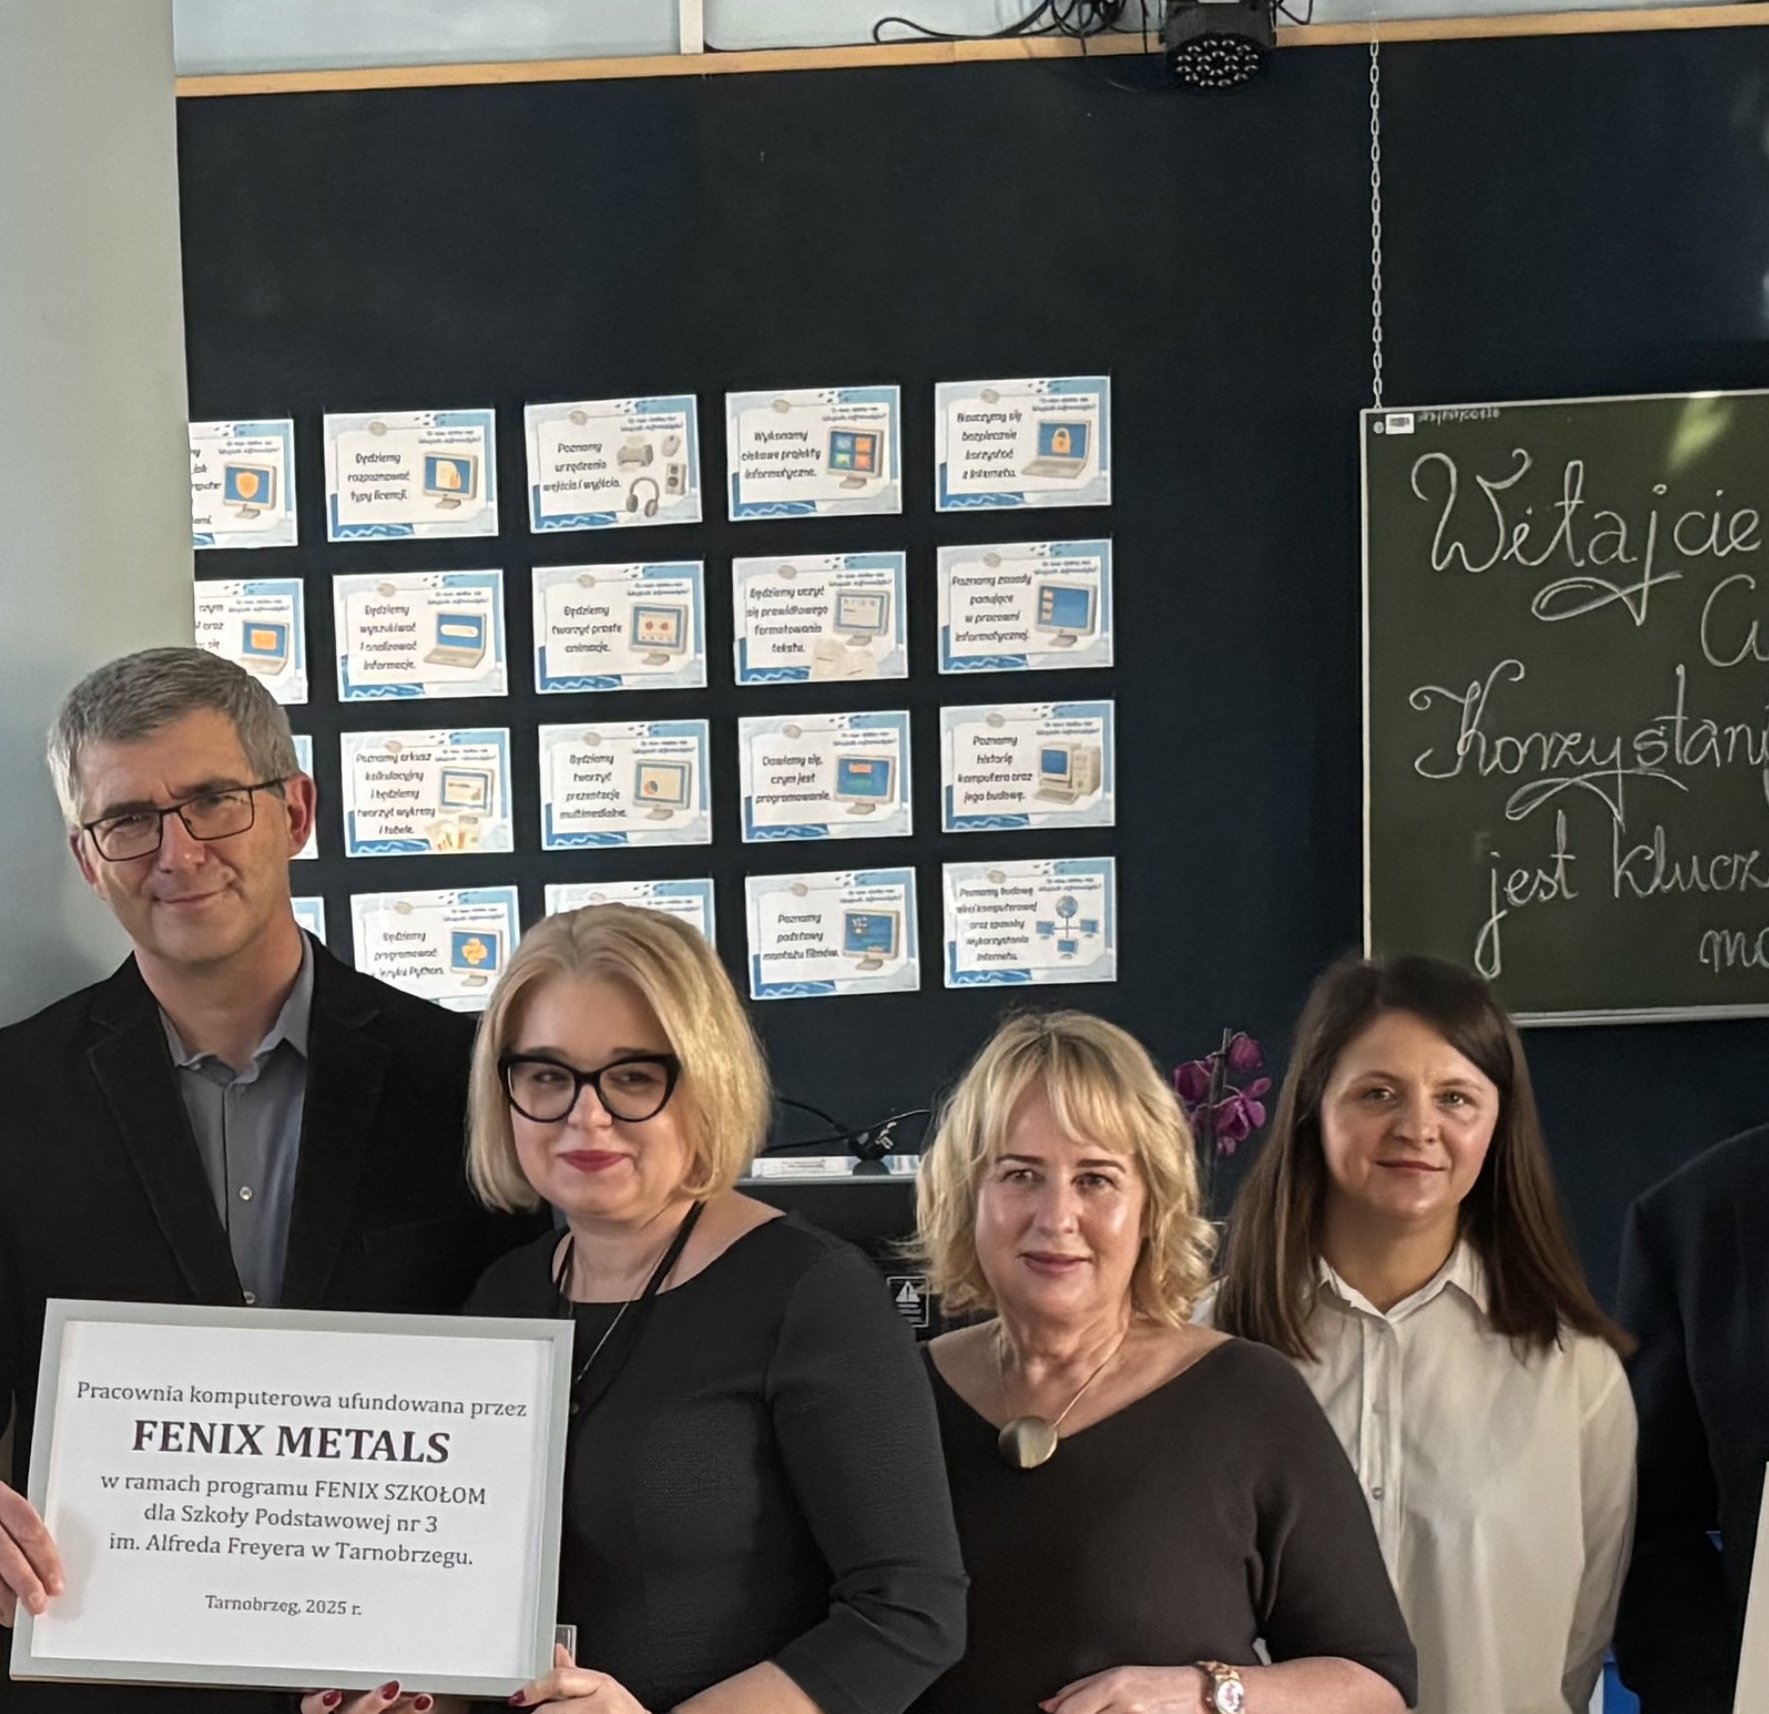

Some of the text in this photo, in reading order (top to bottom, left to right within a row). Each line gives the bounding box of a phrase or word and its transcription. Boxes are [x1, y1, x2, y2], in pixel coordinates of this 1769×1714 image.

[1411, 447, 1761, 626] Witajcie
[1475, 810, 1579, 980] jest
[77, 1381, 527, 1419] Pracownia komputerowa ufundowana przez
[132, 1419, 451, 1464] FENIX METALS
[100, 1474, 487, 1506] w ramach programu FENIX SZKOŁOM
[143, 1502, 438, 1534] dla Szkoły Podstawowej nr 3
[109, 1532, 474, 1569] im. Alfreda Freyera w Tarnobrzegu.
[205, 1594, 363, 1617] Tarnobrzeg, 2025 r.
